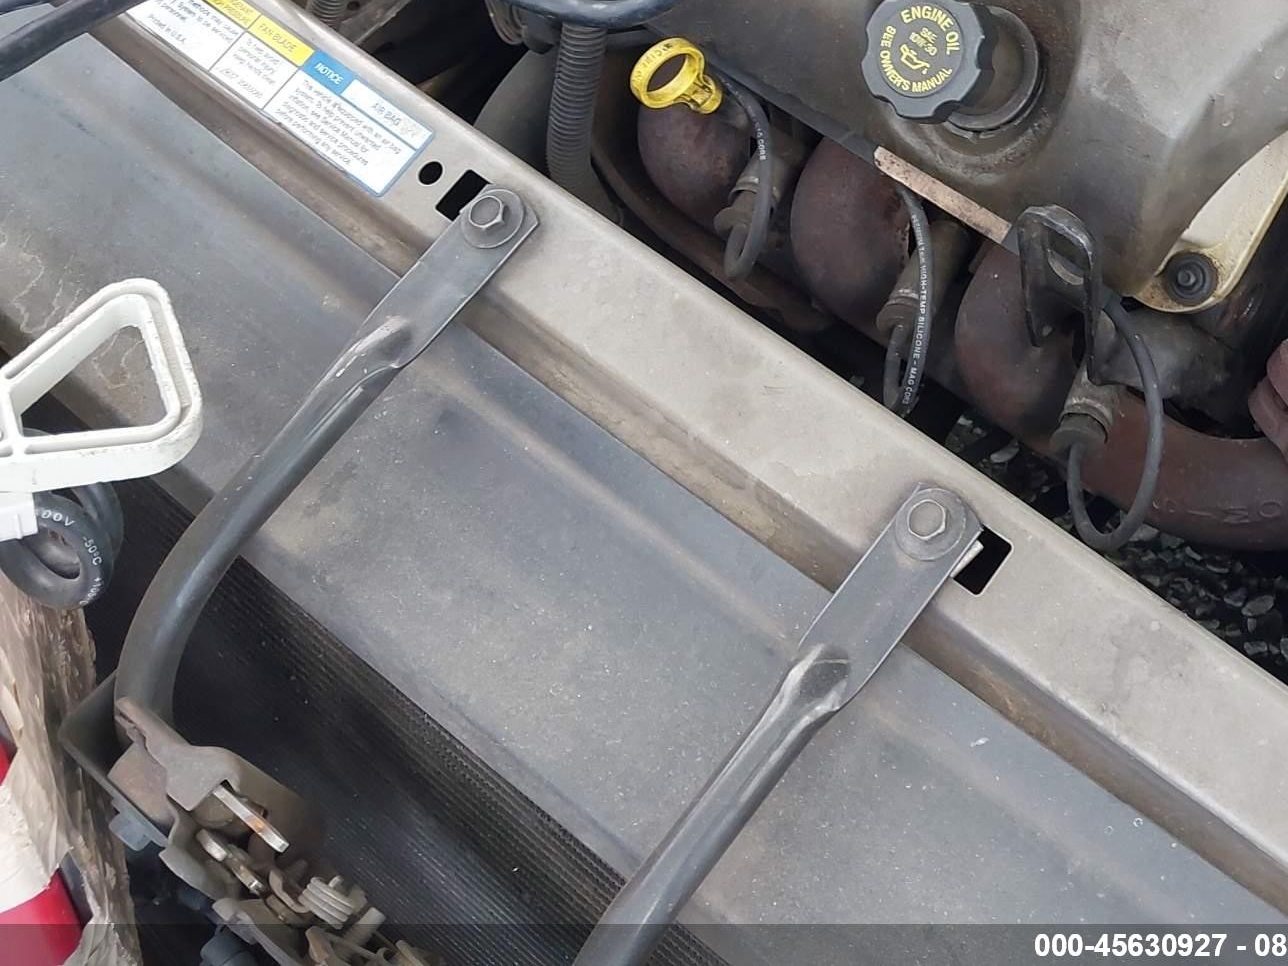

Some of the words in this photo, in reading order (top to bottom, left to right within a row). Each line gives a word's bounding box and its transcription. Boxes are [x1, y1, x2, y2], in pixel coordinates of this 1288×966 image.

[901, 5, 954, 32] ENGINE
[945, 31, 960, 55] OIL
[313, 60, 344, 85] NOTICE
[911, 67, 953, 93] MANUAL
[920, 265, 928, 314] HIGH-TEMP
[913, 316, 925, 359] SILICONE
[907, 367, 918, 385] MAG
